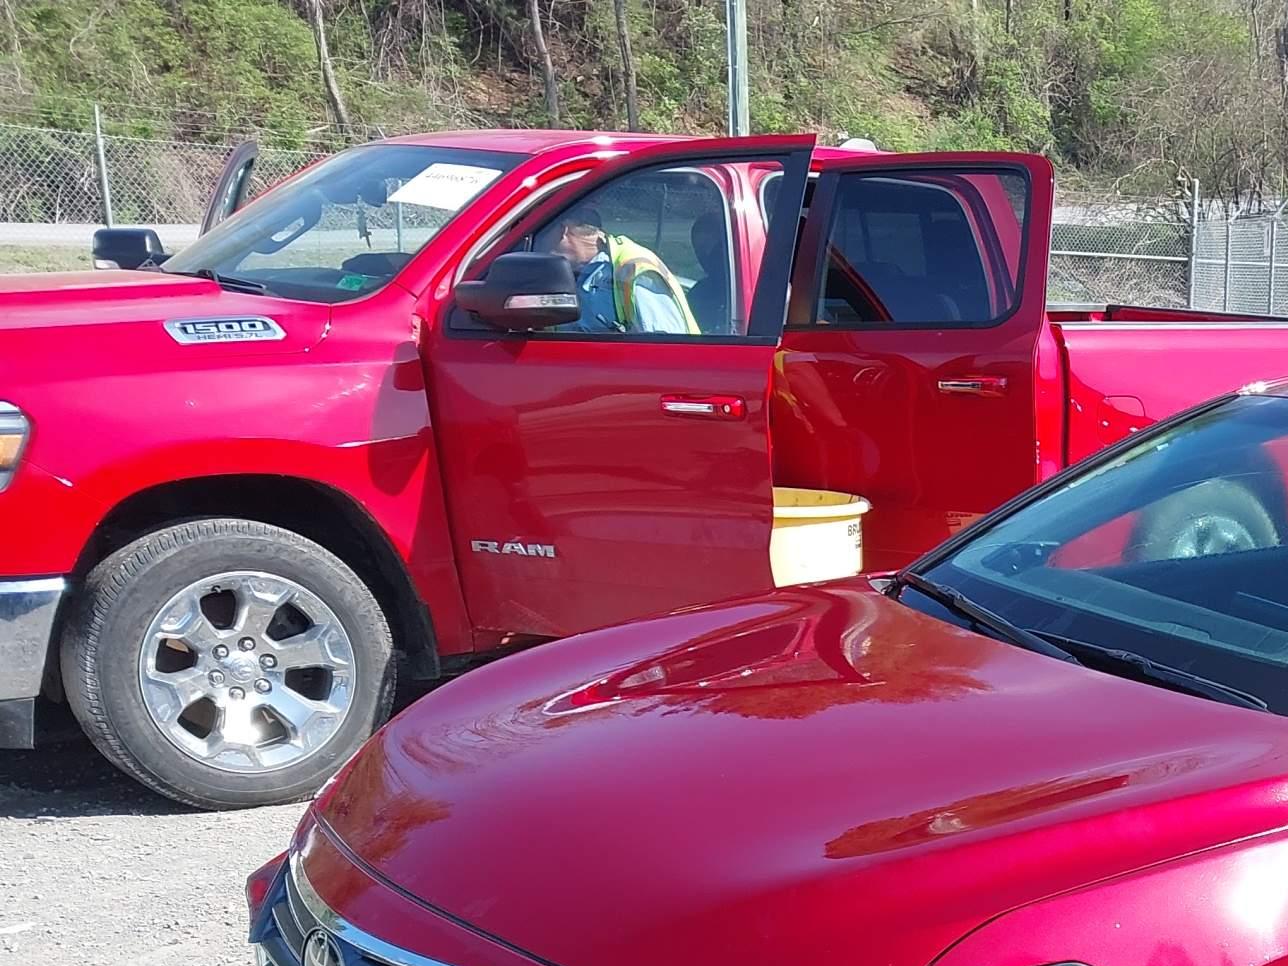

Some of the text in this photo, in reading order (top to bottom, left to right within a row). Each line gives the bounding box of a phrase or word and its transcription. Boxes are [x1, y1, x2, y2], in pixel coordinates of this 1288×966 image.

[174, 321, 265, 334] 1500
[196, 332, 232, 340] HEMI
[471, 540, 555, 558] RAM
